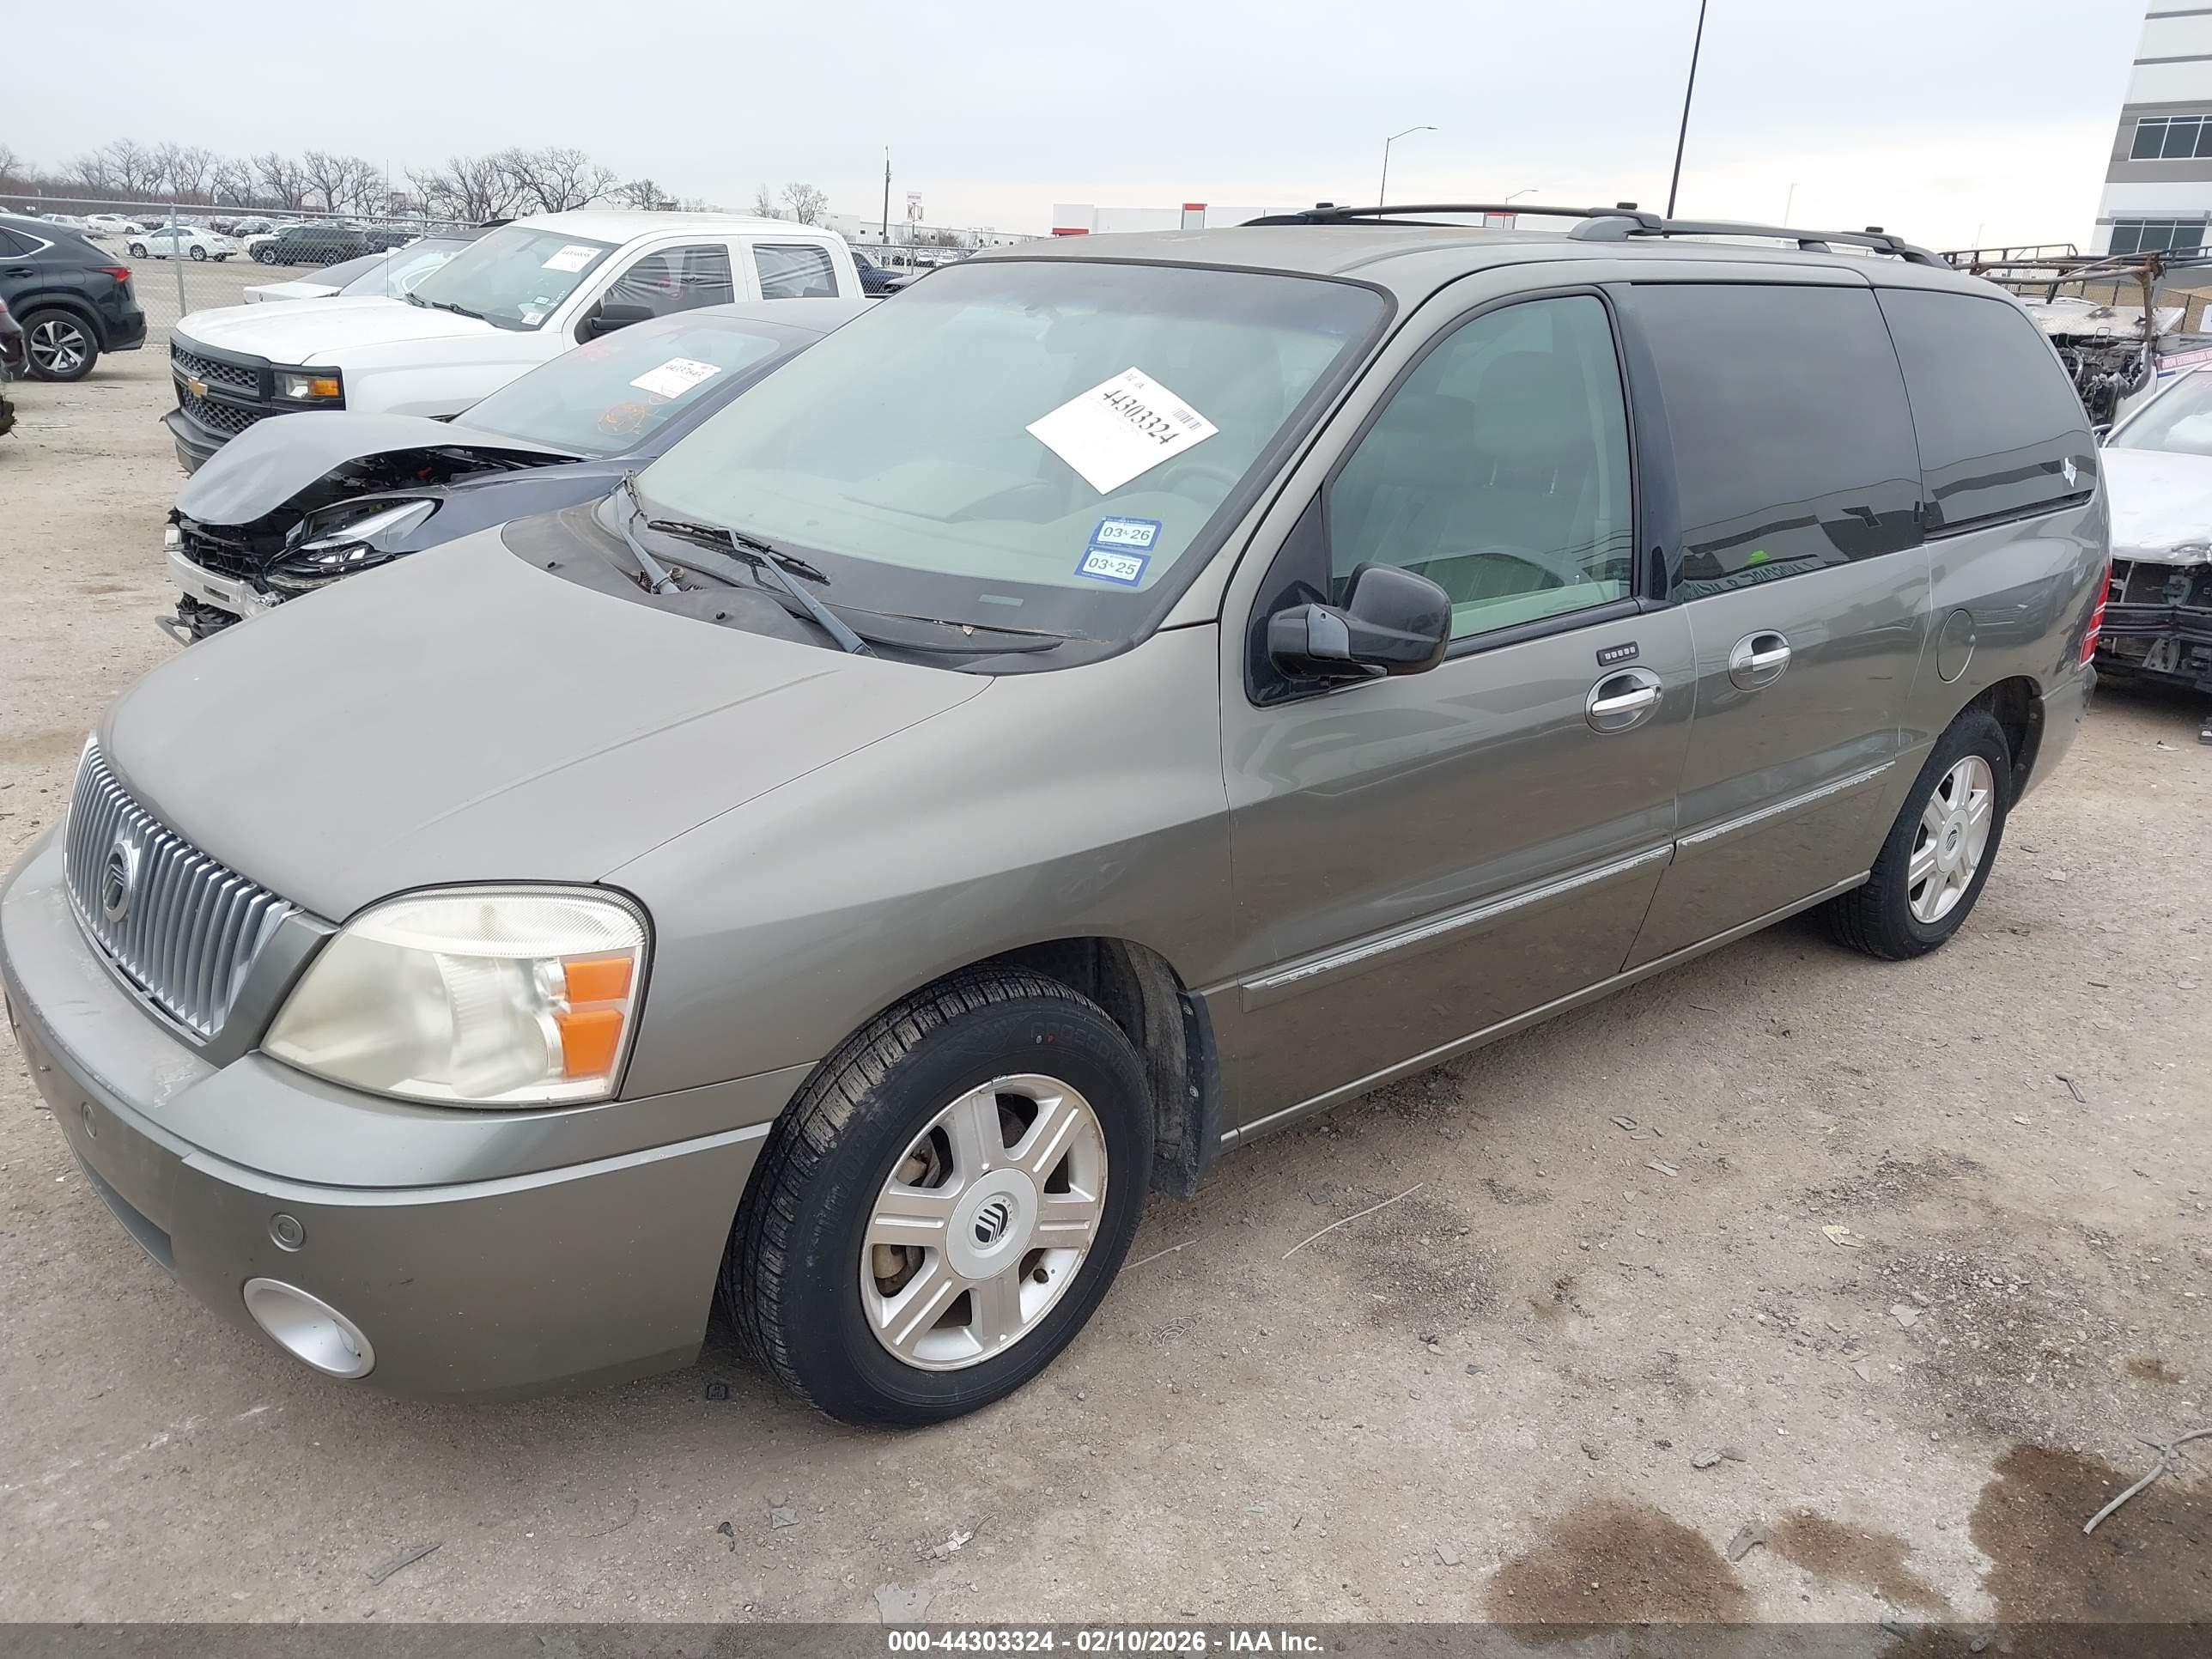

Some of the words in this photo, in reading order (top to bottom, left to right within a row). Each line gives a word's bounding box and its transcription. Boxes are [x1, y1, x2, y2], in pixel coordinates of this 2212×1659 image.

[1103, 389, 1180, 444] 44303324
[1103, 526, 1123, 538] 03
[1130, 529, 1151, 541] 26
[1088, 557, 1109, 569] 03
[1115, 562, 1137, 575] 25
